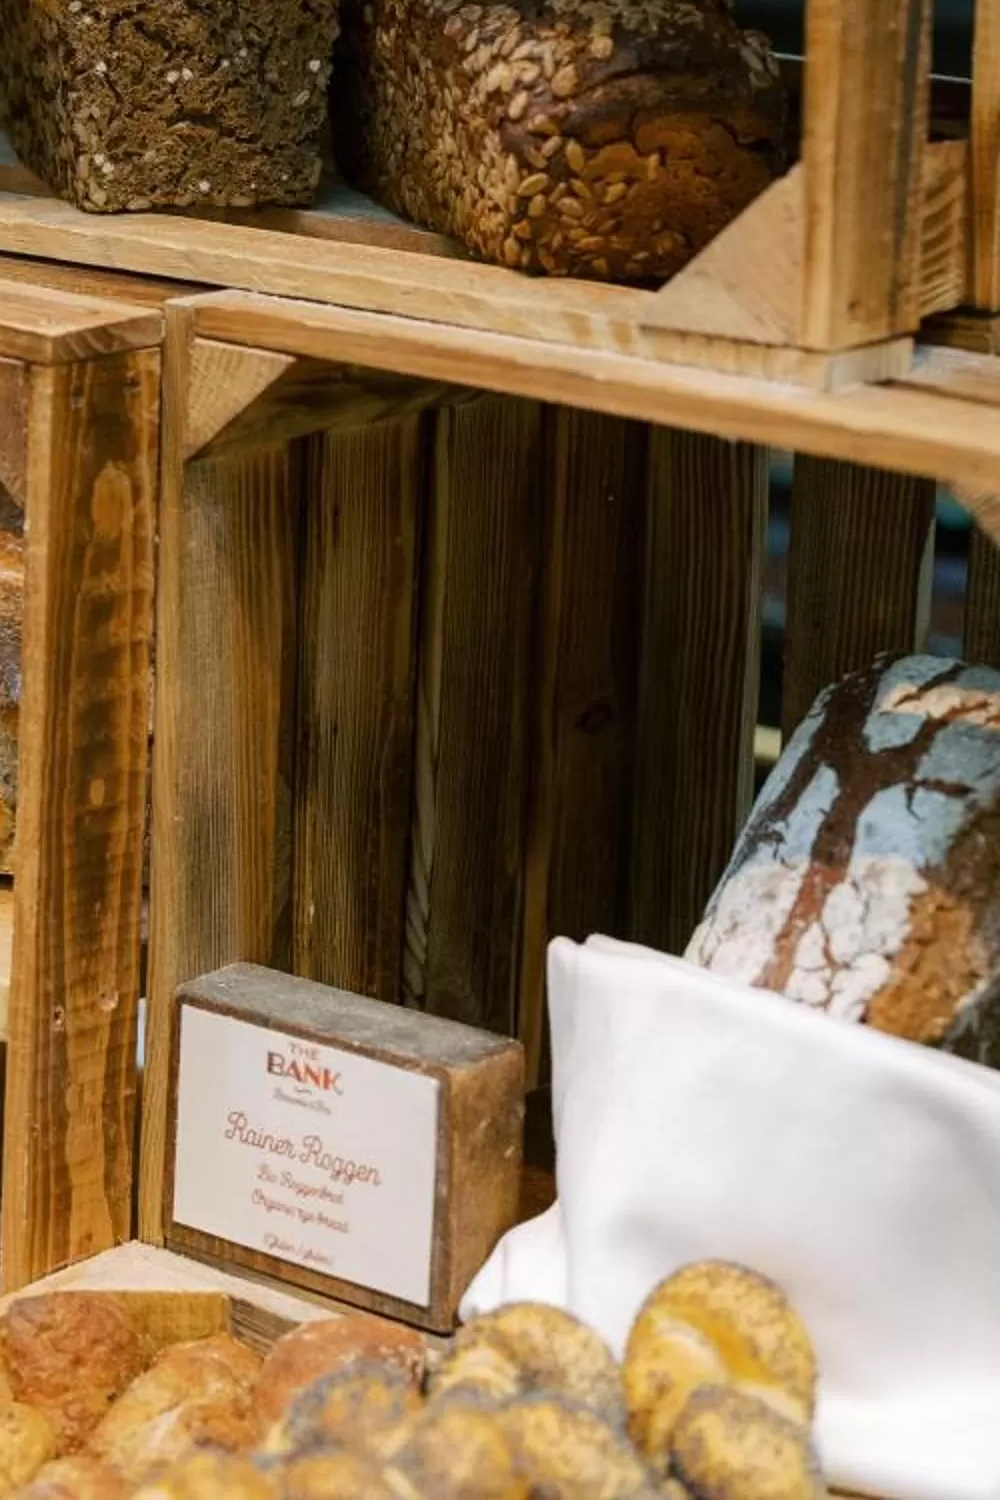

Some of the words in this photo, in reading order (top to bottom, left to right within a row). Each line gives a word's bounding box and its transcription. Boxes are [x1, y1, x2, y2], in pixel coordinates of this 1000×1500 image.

[268, 1051, 344, 1096] BANK
[290, 1042, 319, 1060] THE
[224, 1112, 297, 1161] Rainer
[299, 1136, 383, 1187] Roggen
